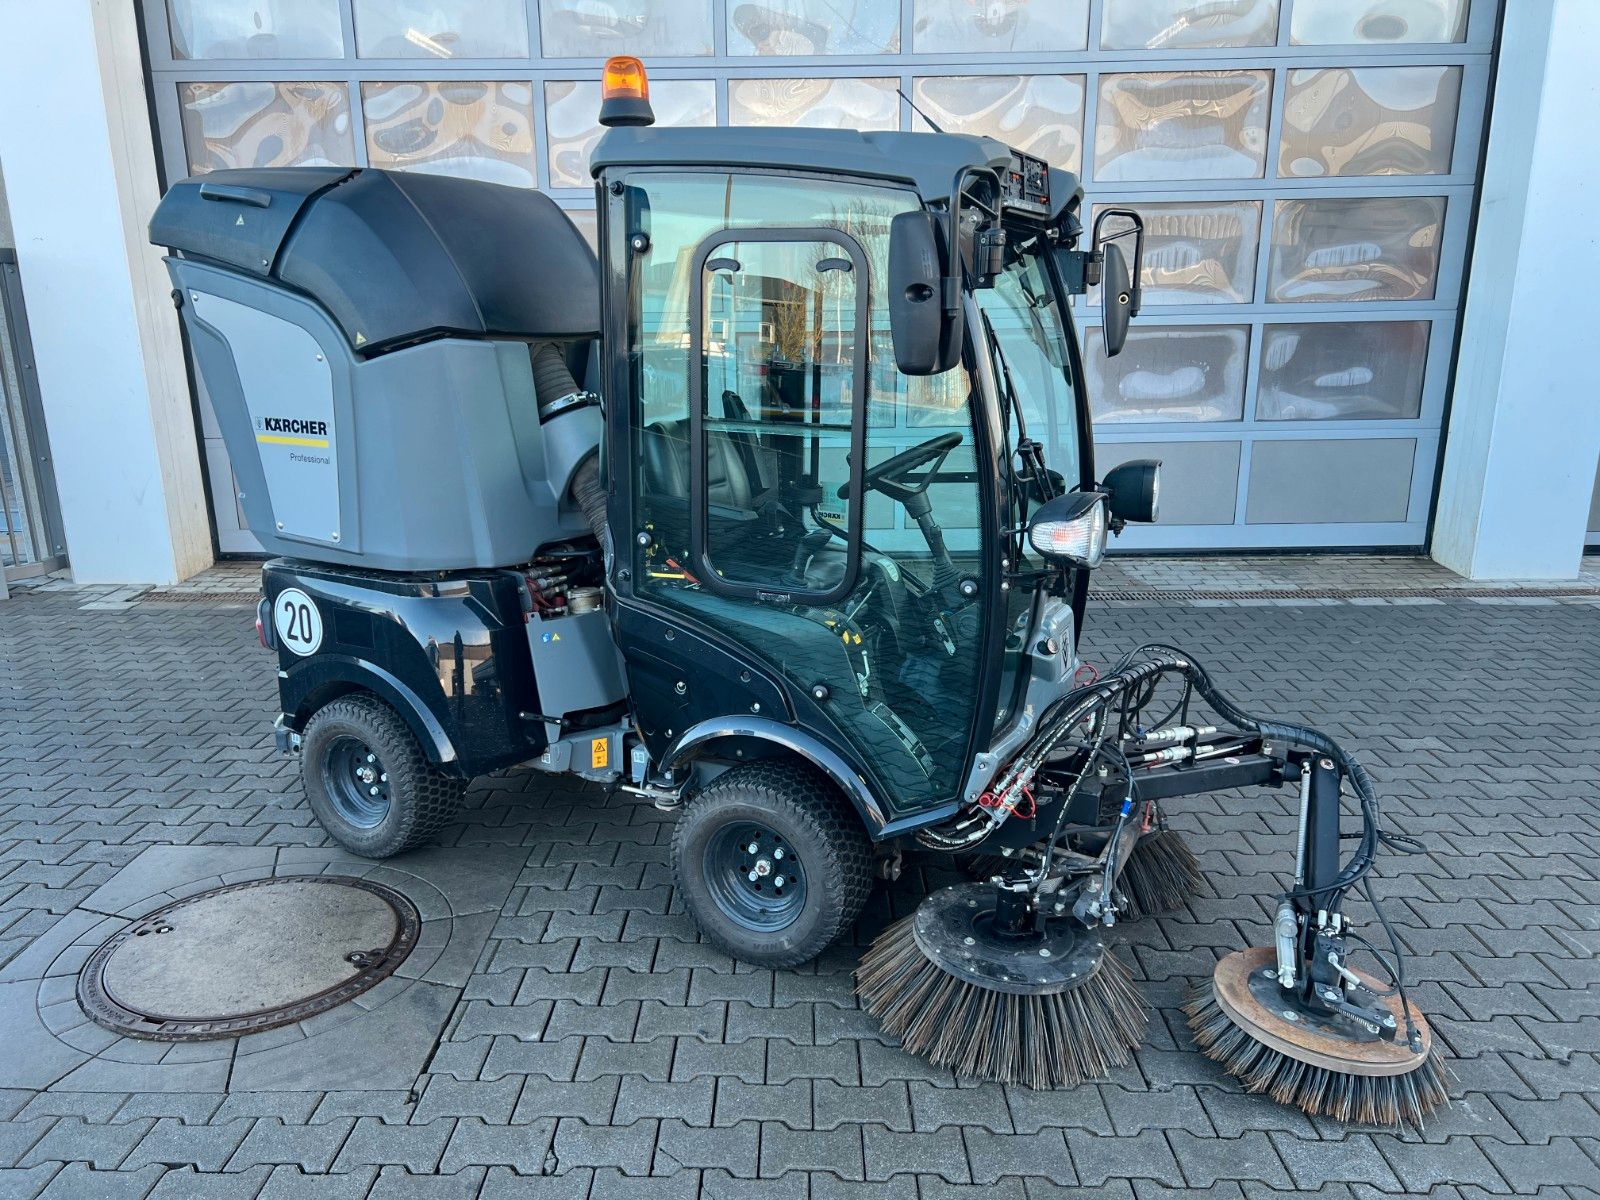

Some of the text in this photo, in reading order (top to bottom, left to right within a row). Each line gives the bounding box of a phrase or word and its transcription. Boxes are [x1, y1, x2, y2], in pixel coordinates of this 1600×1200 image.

[264, 417, 327, 435] KÄRCHER
[290, 452, 330, 464] Professional
[284, 601, 313, 644] 20
